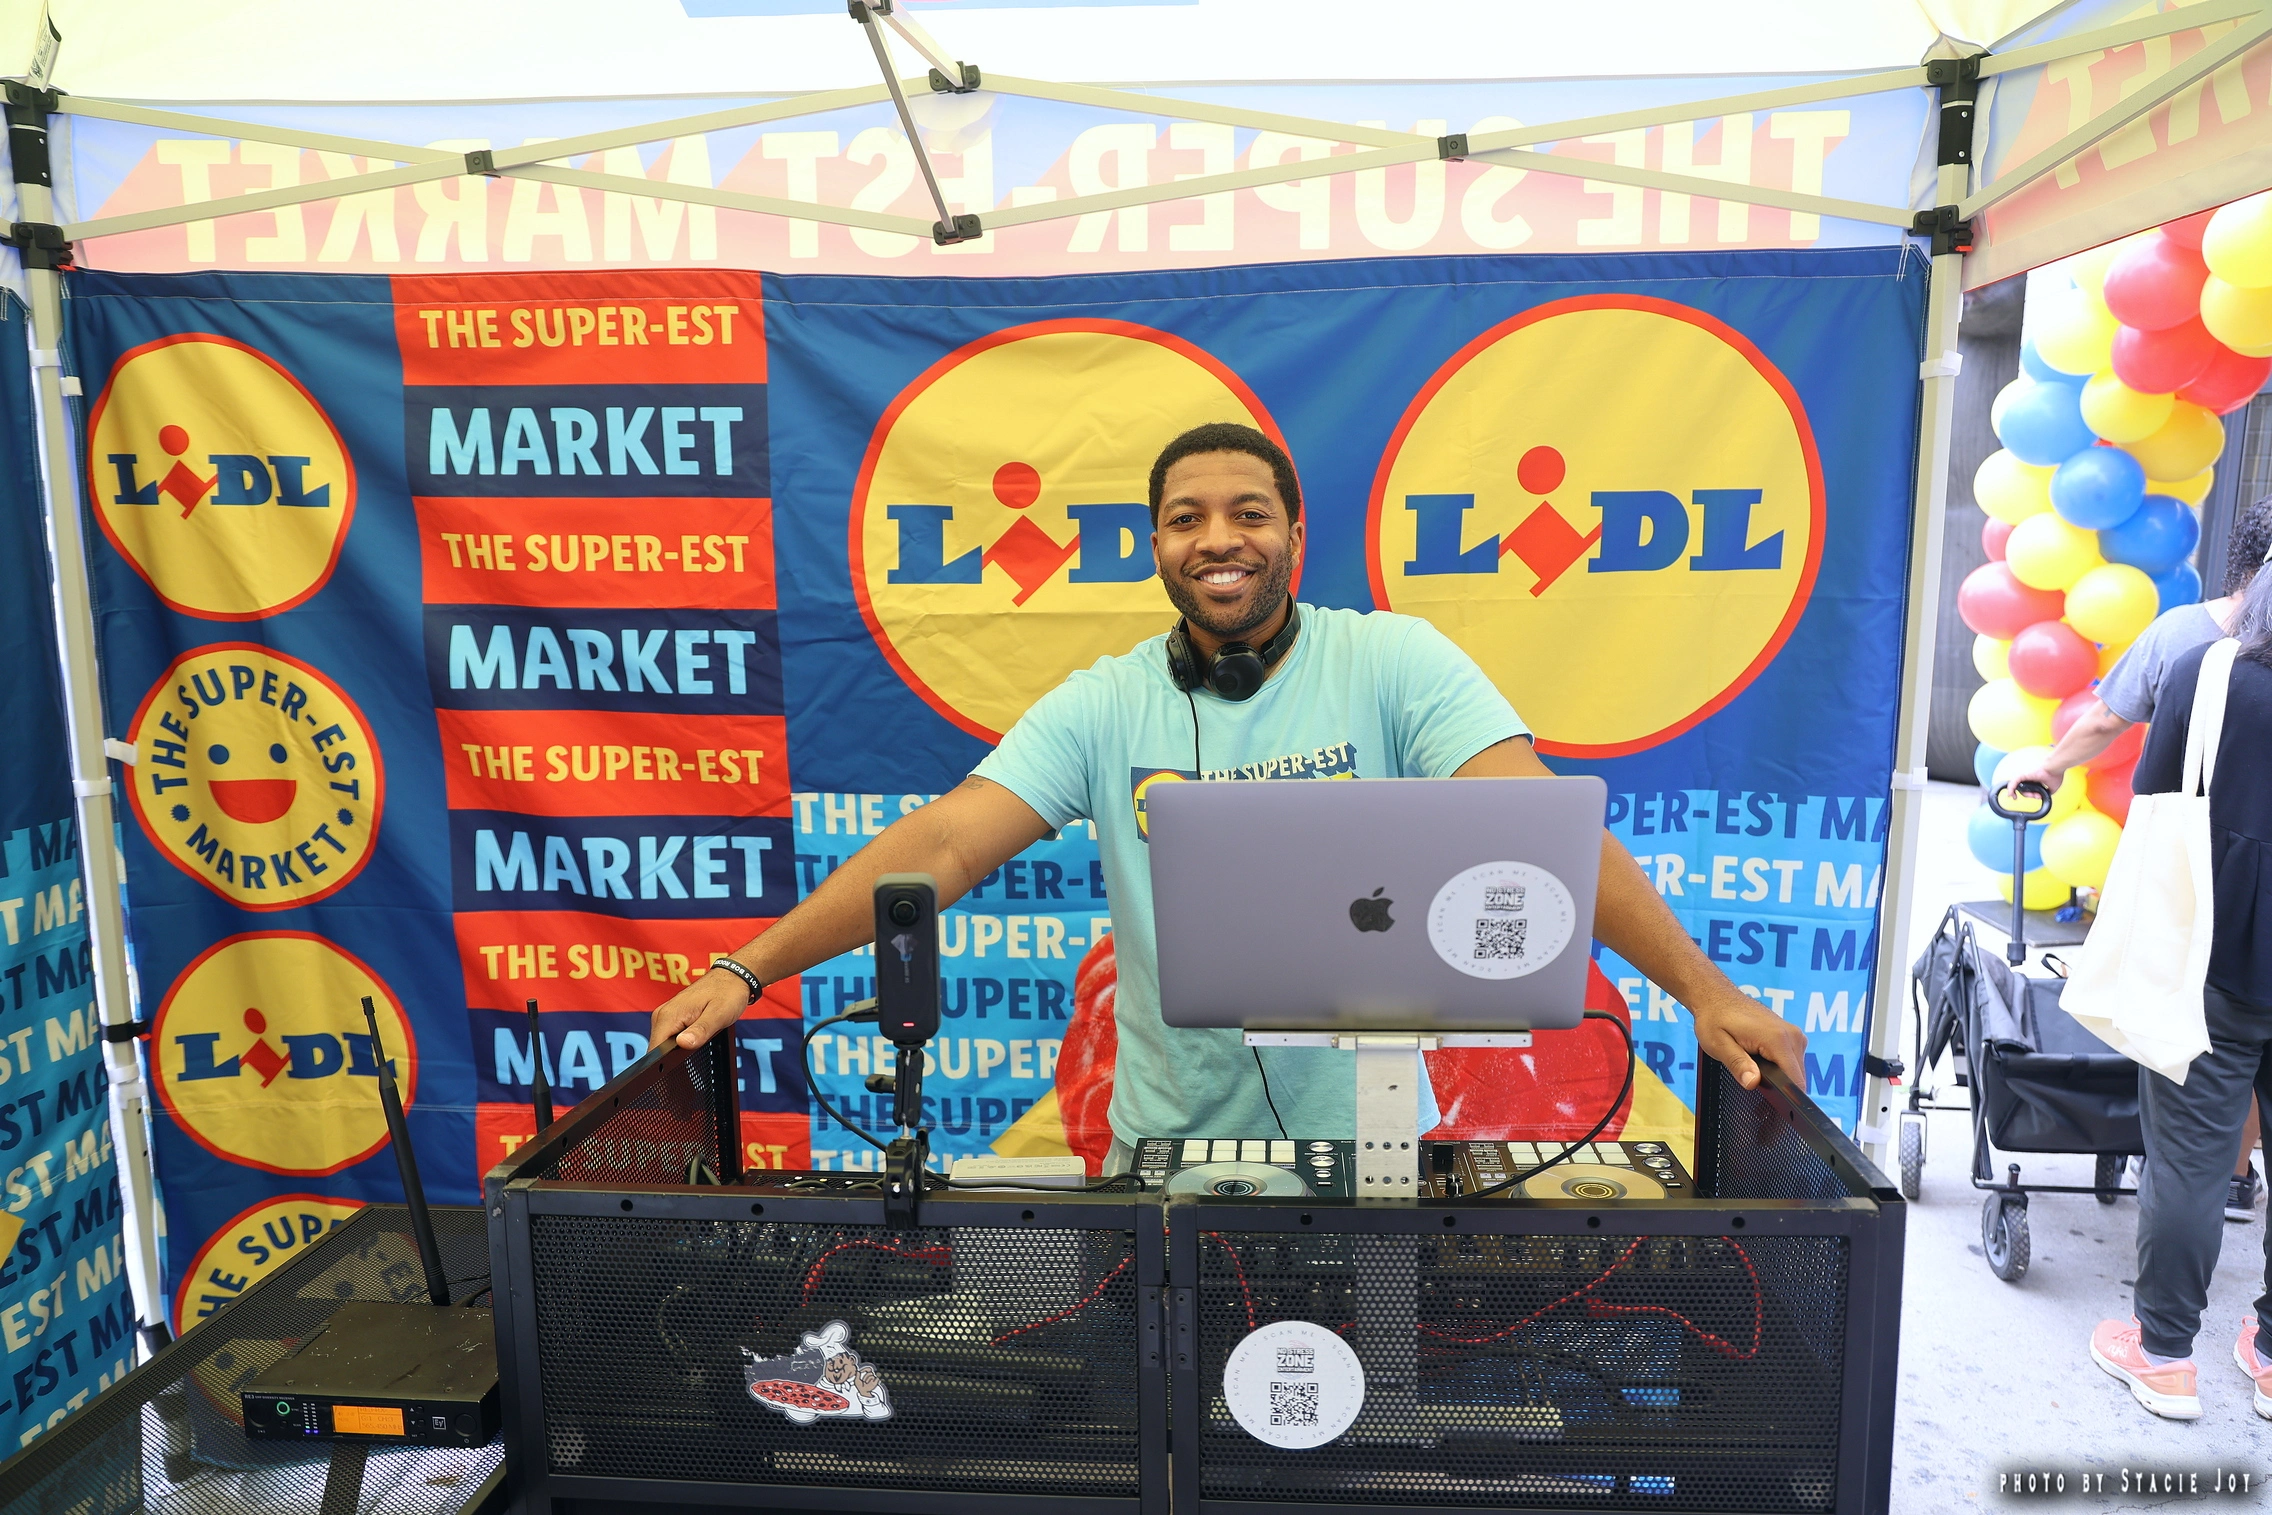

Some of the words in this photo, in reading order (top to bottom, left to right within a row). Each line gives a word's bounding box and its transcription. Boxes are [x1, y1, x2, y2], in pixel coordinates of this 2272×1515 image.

[419, 308, 501, 349] THE
[512, 305, 740, 347] SUPER-EST
[429, 406, 744, 477] MARKET
[441, 532, 519, 573] THE
[527, 533, 749, 574] SUPER-EST
[449, 625, 756, 695] MARKET
[151, 711, 189, 795] THE
[177, 665, 359, 801] SUPER-EST
[461, 743, 536, 784] THE
[545, 745, 764, 785] SUPER-EST
[1242, 741, 1349, 782] SUPER-EST
[791, 793, 885, 835] THE
[185, 822, 346, 890] MARKET
[475, 829, 772, 901] MARKET
[1485, 893, 1525, 907] ZONE
[479, 944, 559, 980] THE
[730, 965, 746, 975] BOB
[744, 972, 759, 989] 101.5
[808, 1034, 896, 1075] THE
[809, 1094, 894, 1132] THE
[1277, 1354, 1314, 1367] ZONE
[1288, 1347, 1314, 1355] STRESS
